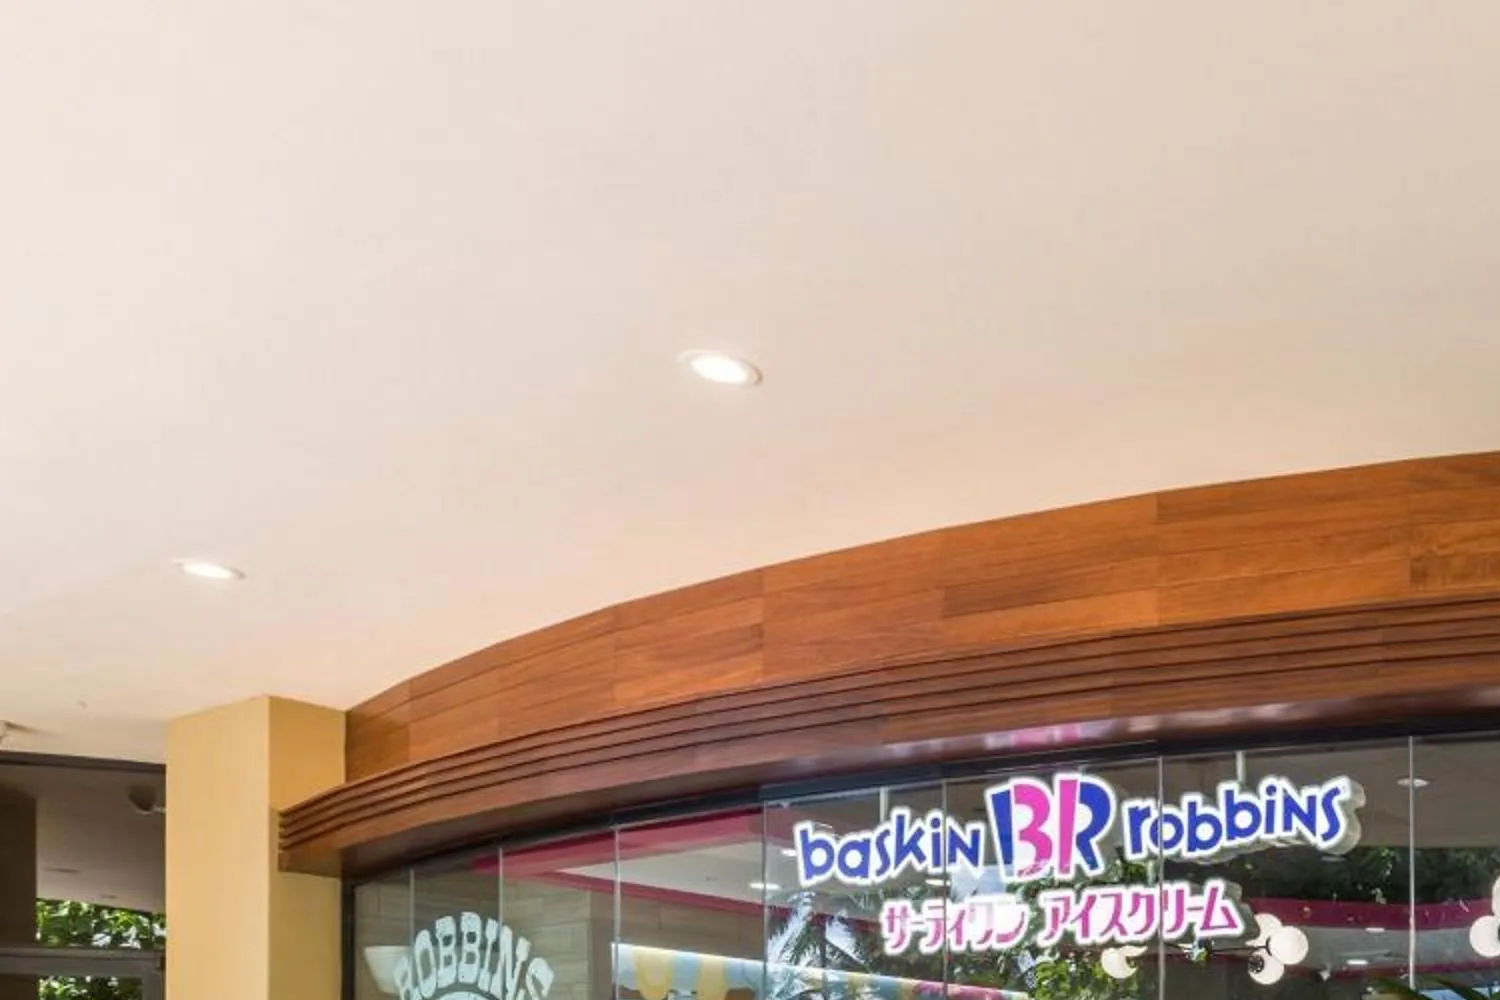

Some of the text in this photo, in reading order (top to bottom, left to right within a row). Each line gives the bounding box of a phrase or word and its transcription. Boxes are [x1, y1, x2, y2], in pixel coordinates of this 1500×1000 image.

[800, 779, 1341, 880] baskin BR robbins
[887, 886, 1237, 949] サーティワン アイスクリーム
